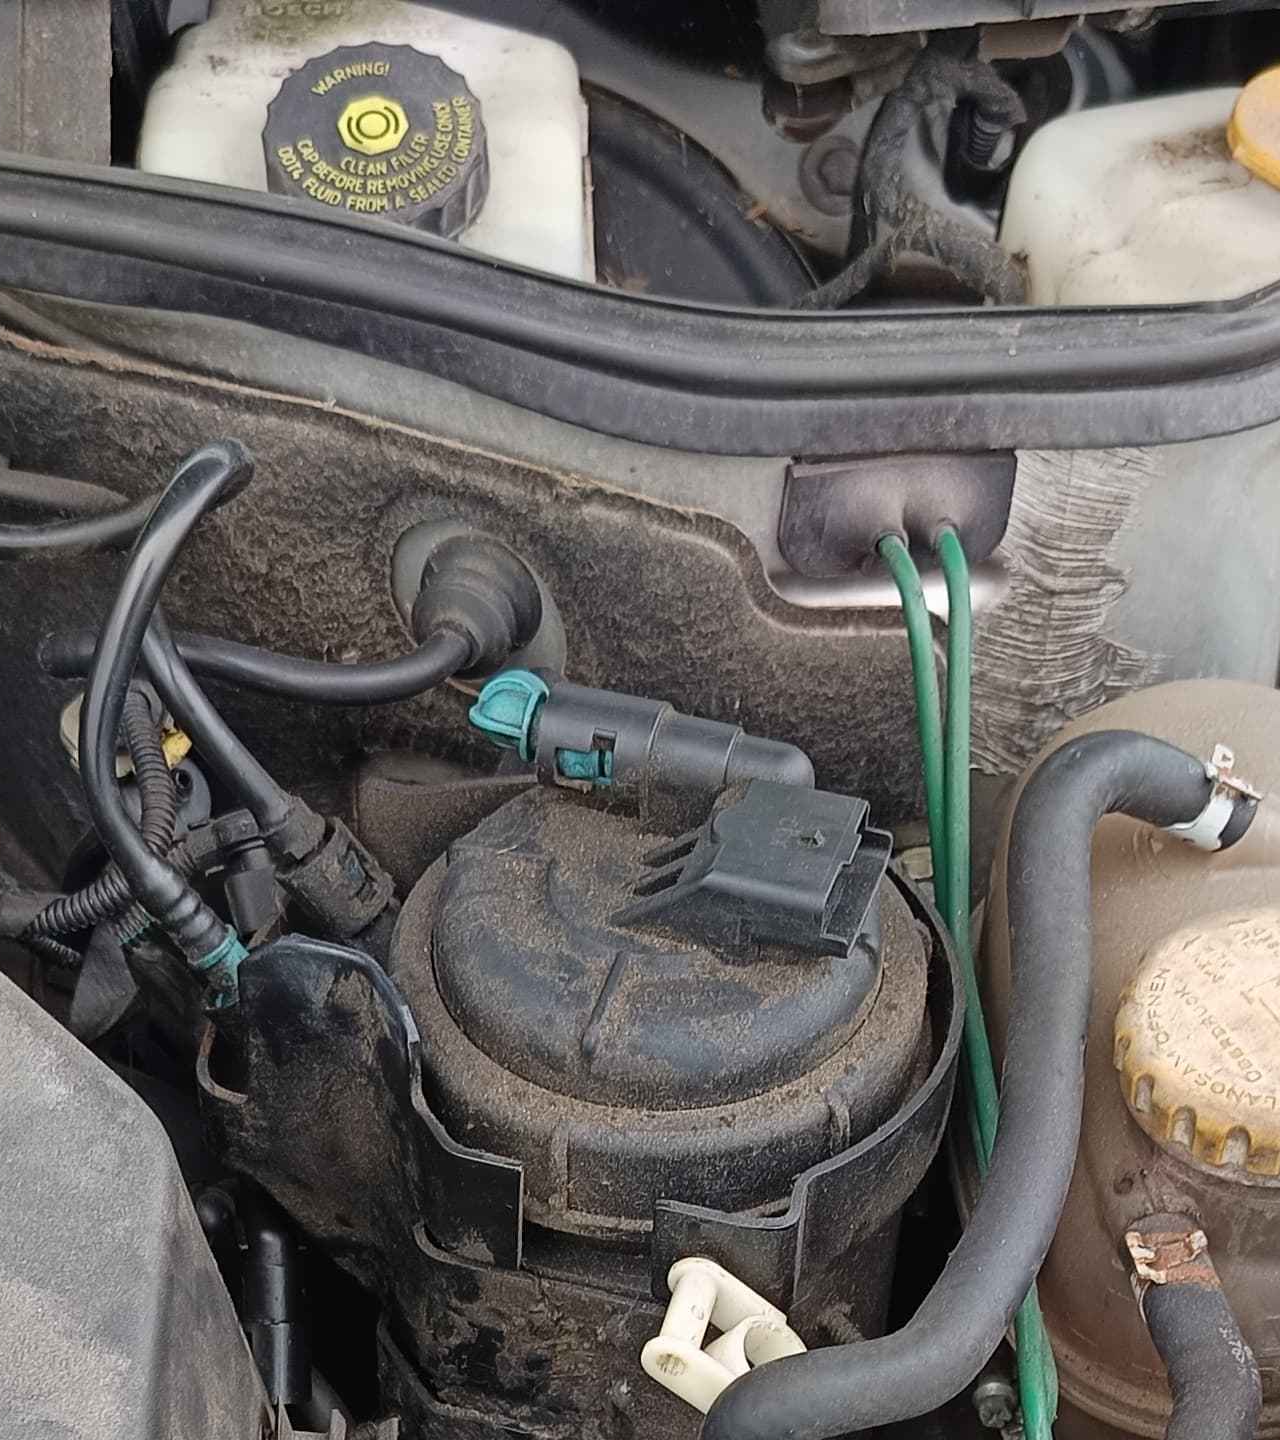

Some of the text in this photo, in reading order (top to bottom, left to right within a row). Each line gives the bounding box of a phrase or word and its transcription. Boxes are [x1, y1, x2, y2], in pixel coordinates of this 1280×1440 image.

[312, 61, 390, 96] WARNING!
[278, 96, 473, 213] DOT4 FLUID FROM A SEALED CONTAINER
[296, 139, 317, 168] CAP
[312, 159, 365, 194] BEFORE
[366, 156, 439, 195] REMOVING
[341, 133, 430, 176] CLEAN FILLER
